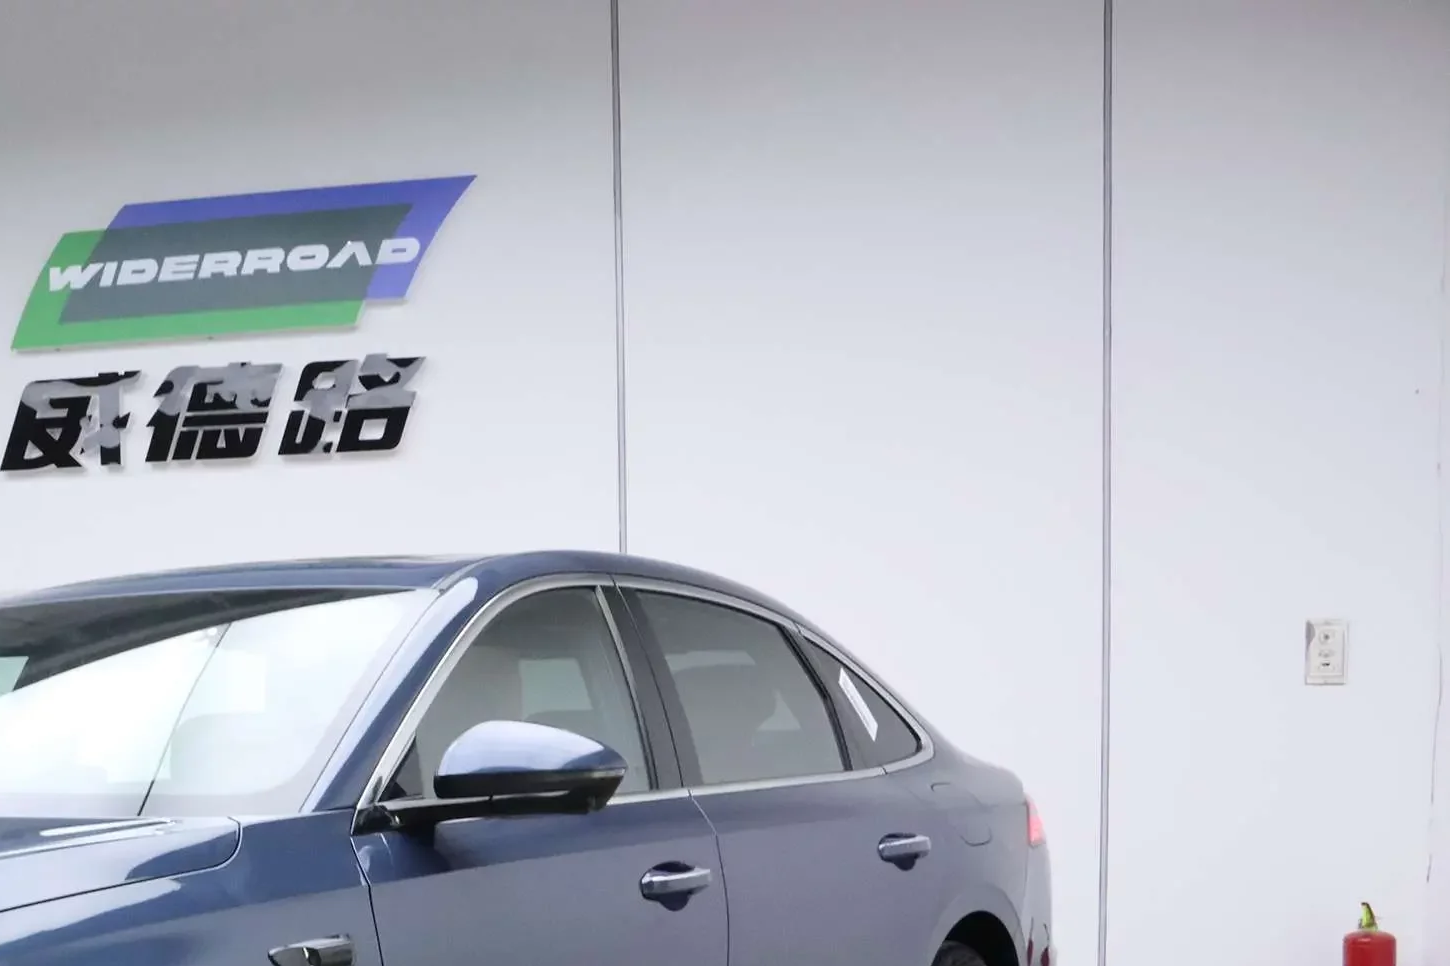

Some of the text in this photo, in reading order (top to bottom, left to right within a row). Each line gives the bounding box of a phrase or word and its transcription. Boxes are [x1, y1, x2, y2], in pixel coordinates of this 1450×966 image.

[49, 237, 420, 291] WIDERROAD
[0, 353, 426, 471] 威德路
